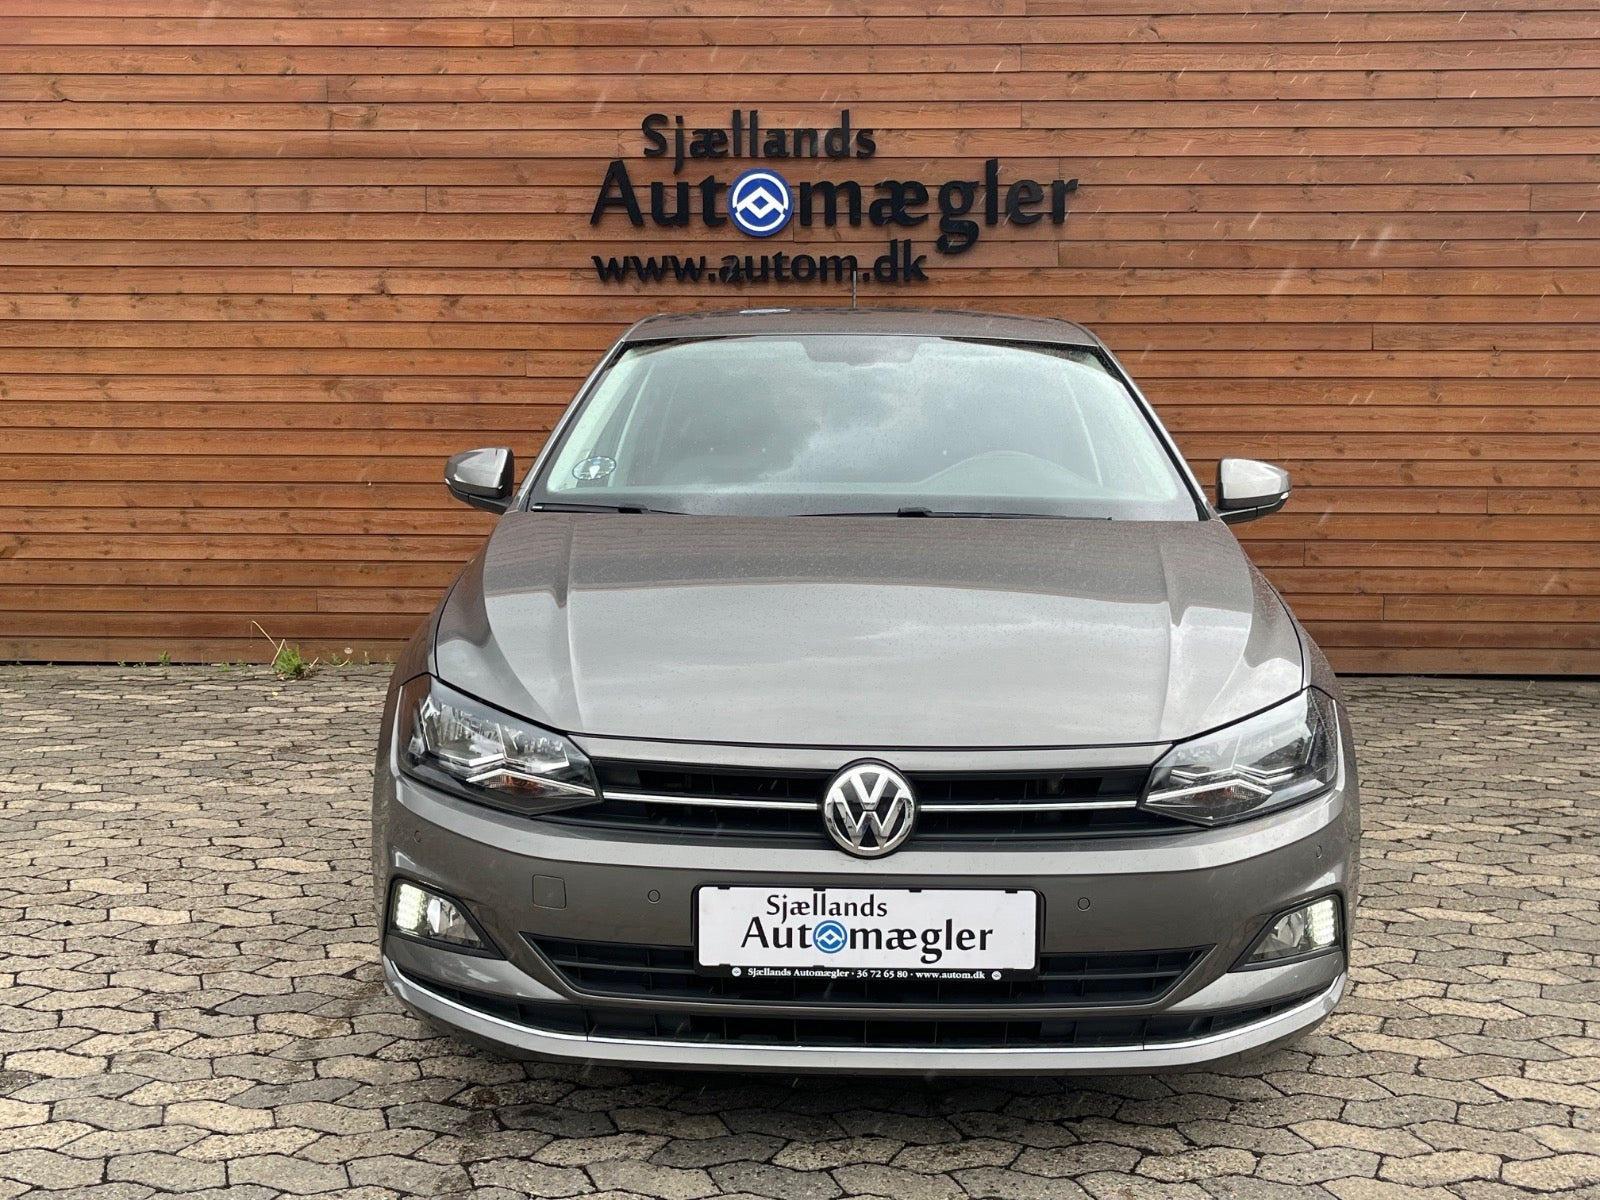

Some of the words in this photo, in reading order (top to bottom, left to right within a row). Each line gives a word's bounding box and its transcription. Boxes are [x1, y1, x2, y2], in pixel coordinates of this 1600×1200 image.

[641, 109, 877, 174] Sjællands
[590, 158, 1079, 254] Automægler
[591, 238, 929, 283] www.autom.dk
[766, 893, 888, 924] Sjællands
[741, 916, 994, 964] Automægler
[747, 967, 791, 978] Sjællands
[793, 968, 849, 979] Automægler
[856, 969, 868, 978] 36
[870, 970, 881, 978] 72
[883, 970, 894, 979] 65
[896, 970, 908, 978] 80
[915, 970, 985, 979] www.autom.dk
